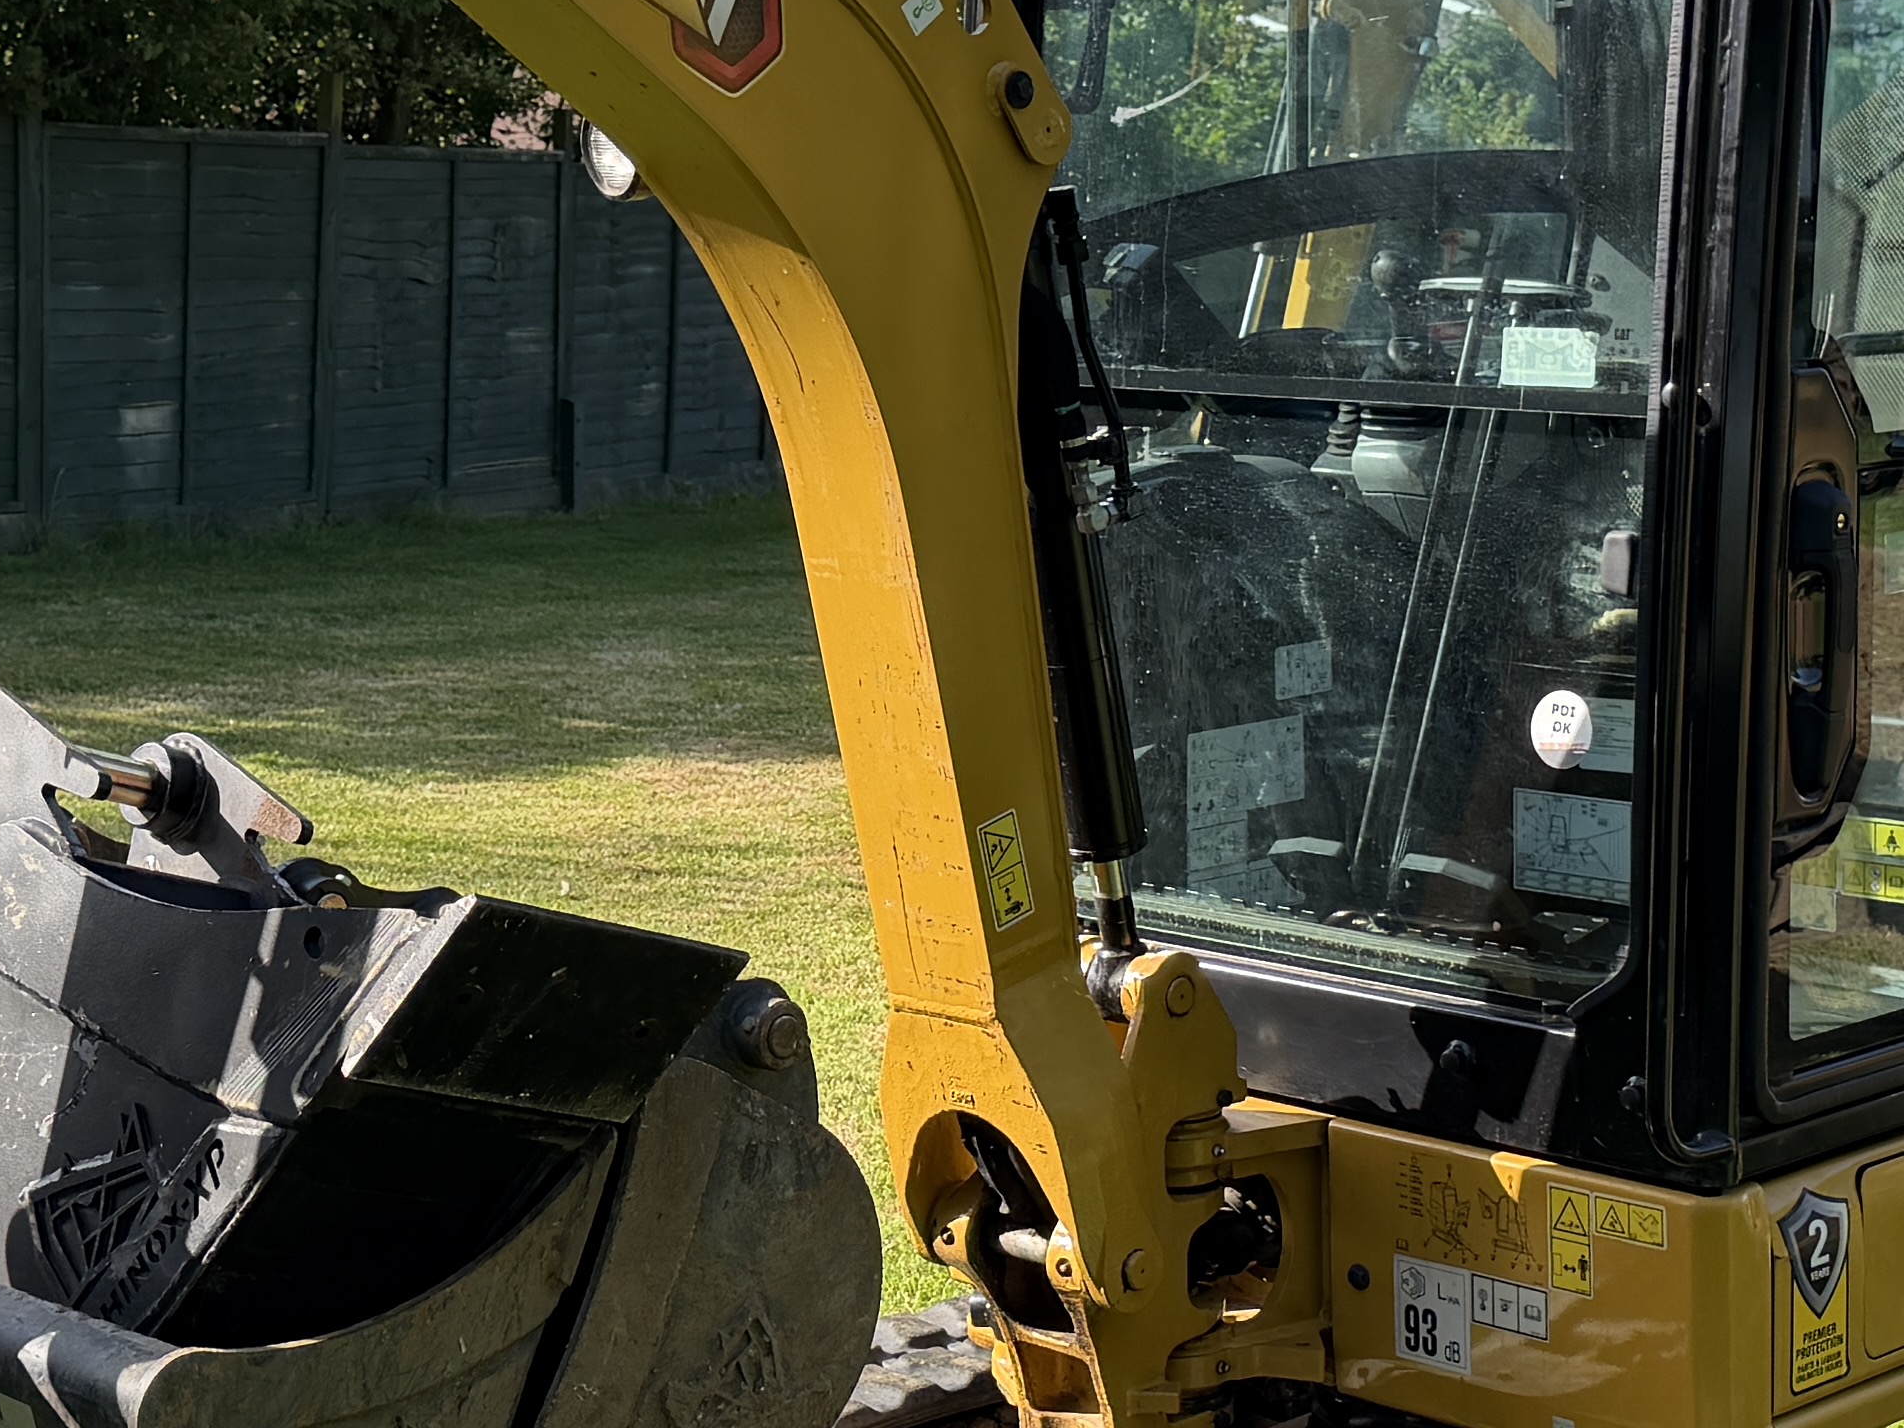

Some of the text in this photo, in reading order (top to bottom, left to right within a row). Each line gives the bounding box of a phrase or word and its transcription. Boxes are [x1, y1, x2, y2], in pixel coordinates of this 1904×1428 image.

[1552, 703, 1576, 718] PDI
[1552, 721, 1572, 734] OK
[99, 1137, 225, 1322] HINOX-XP
[1808, 1218, 1830, 1268] 2
[1404, 1304, 1438, 1357] 93
[1803, 1322, 1837, 1345] PREMIER
[1444, 1340, 1461, 1364] dB
